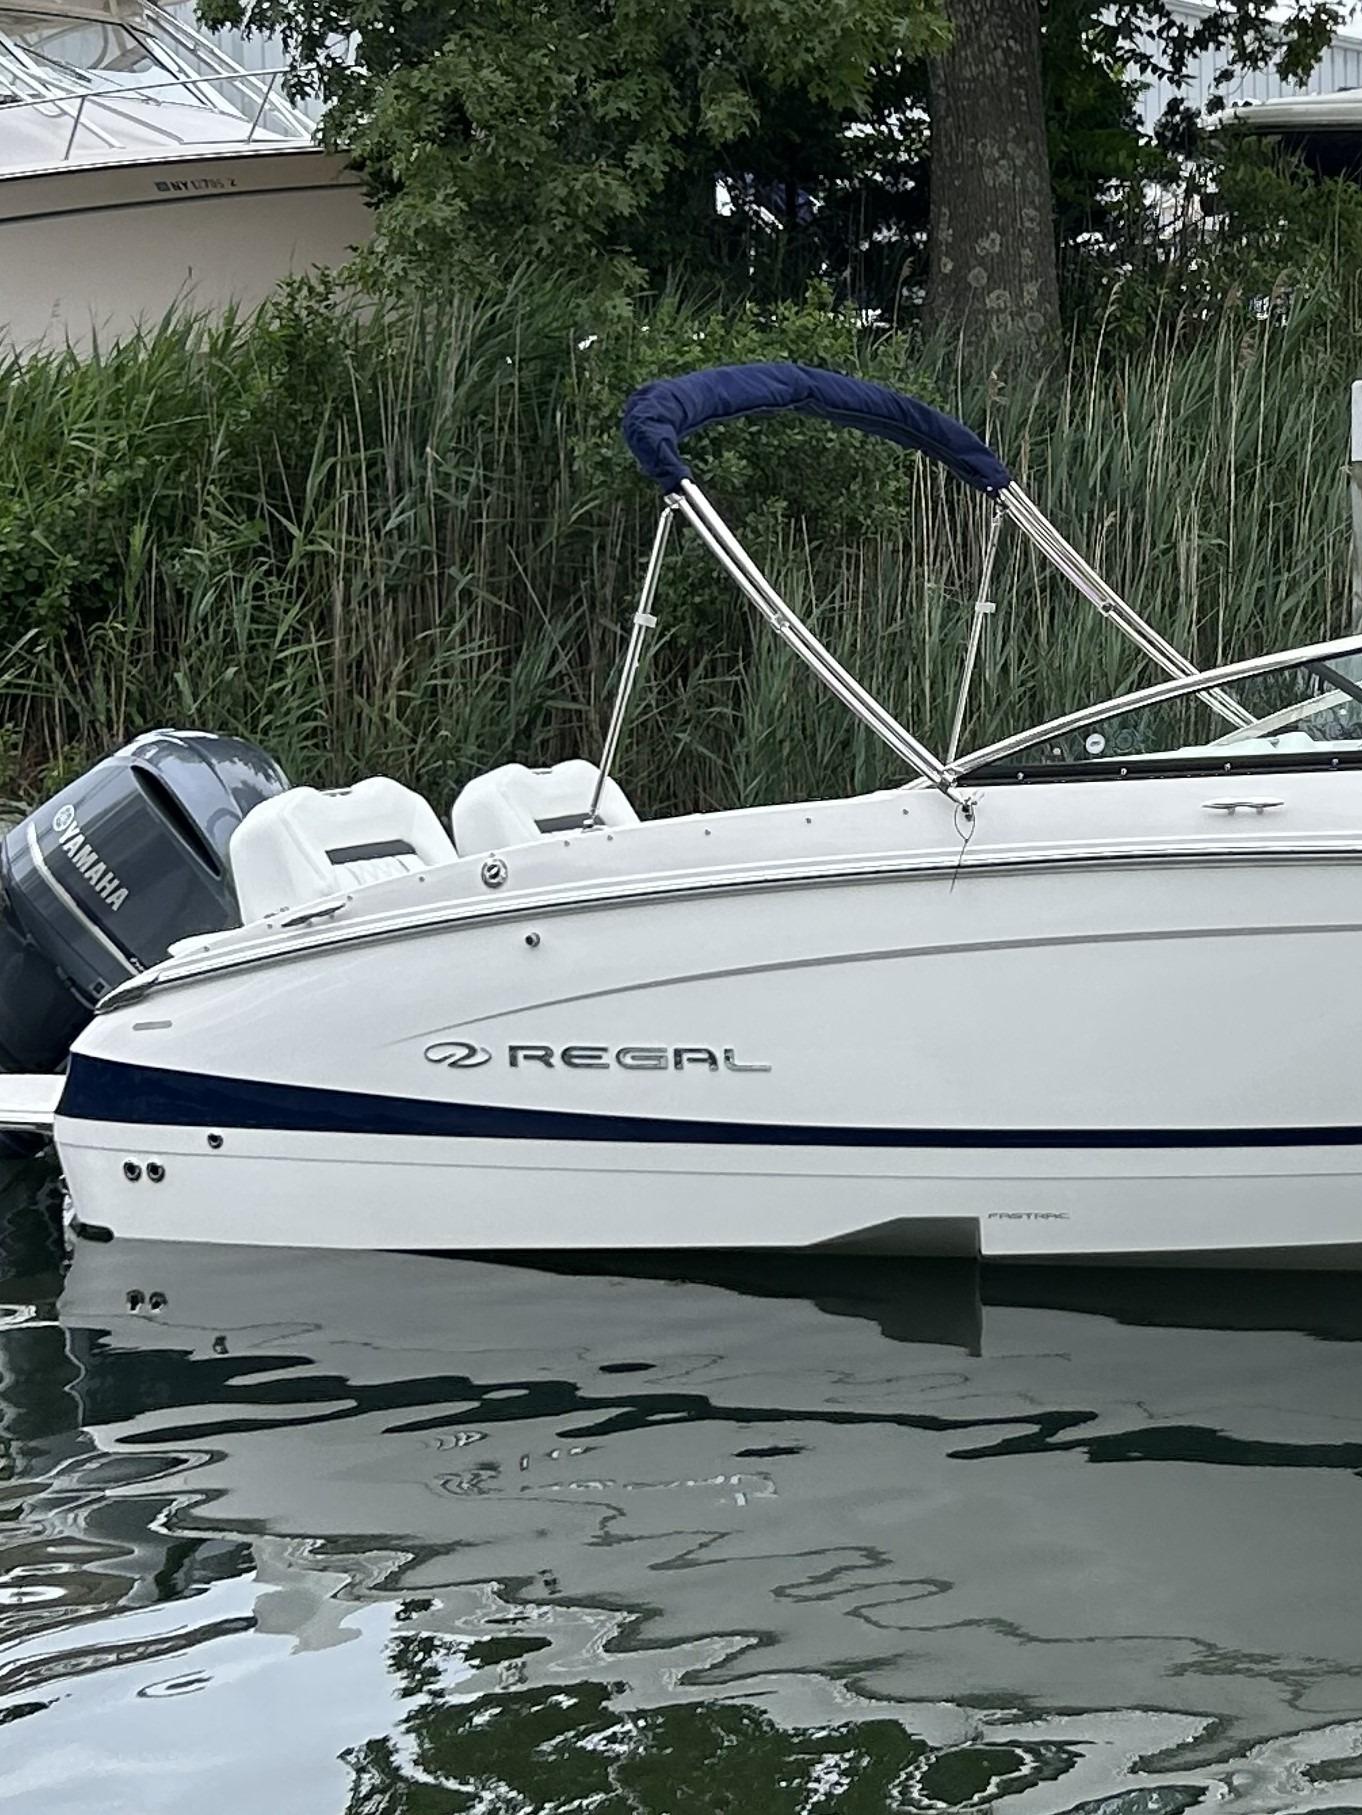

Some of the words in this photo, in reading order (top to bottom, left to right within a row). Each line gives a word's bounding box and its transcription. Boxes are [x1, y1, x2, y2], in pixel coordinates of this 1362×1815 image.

[170, 180, 189, 191] NY
[58, 819, 130, 912] YAMAHA
[507, 1044, 772, 1073] REGAL
[987, 1211, 1071, 1220] FASTRAC
